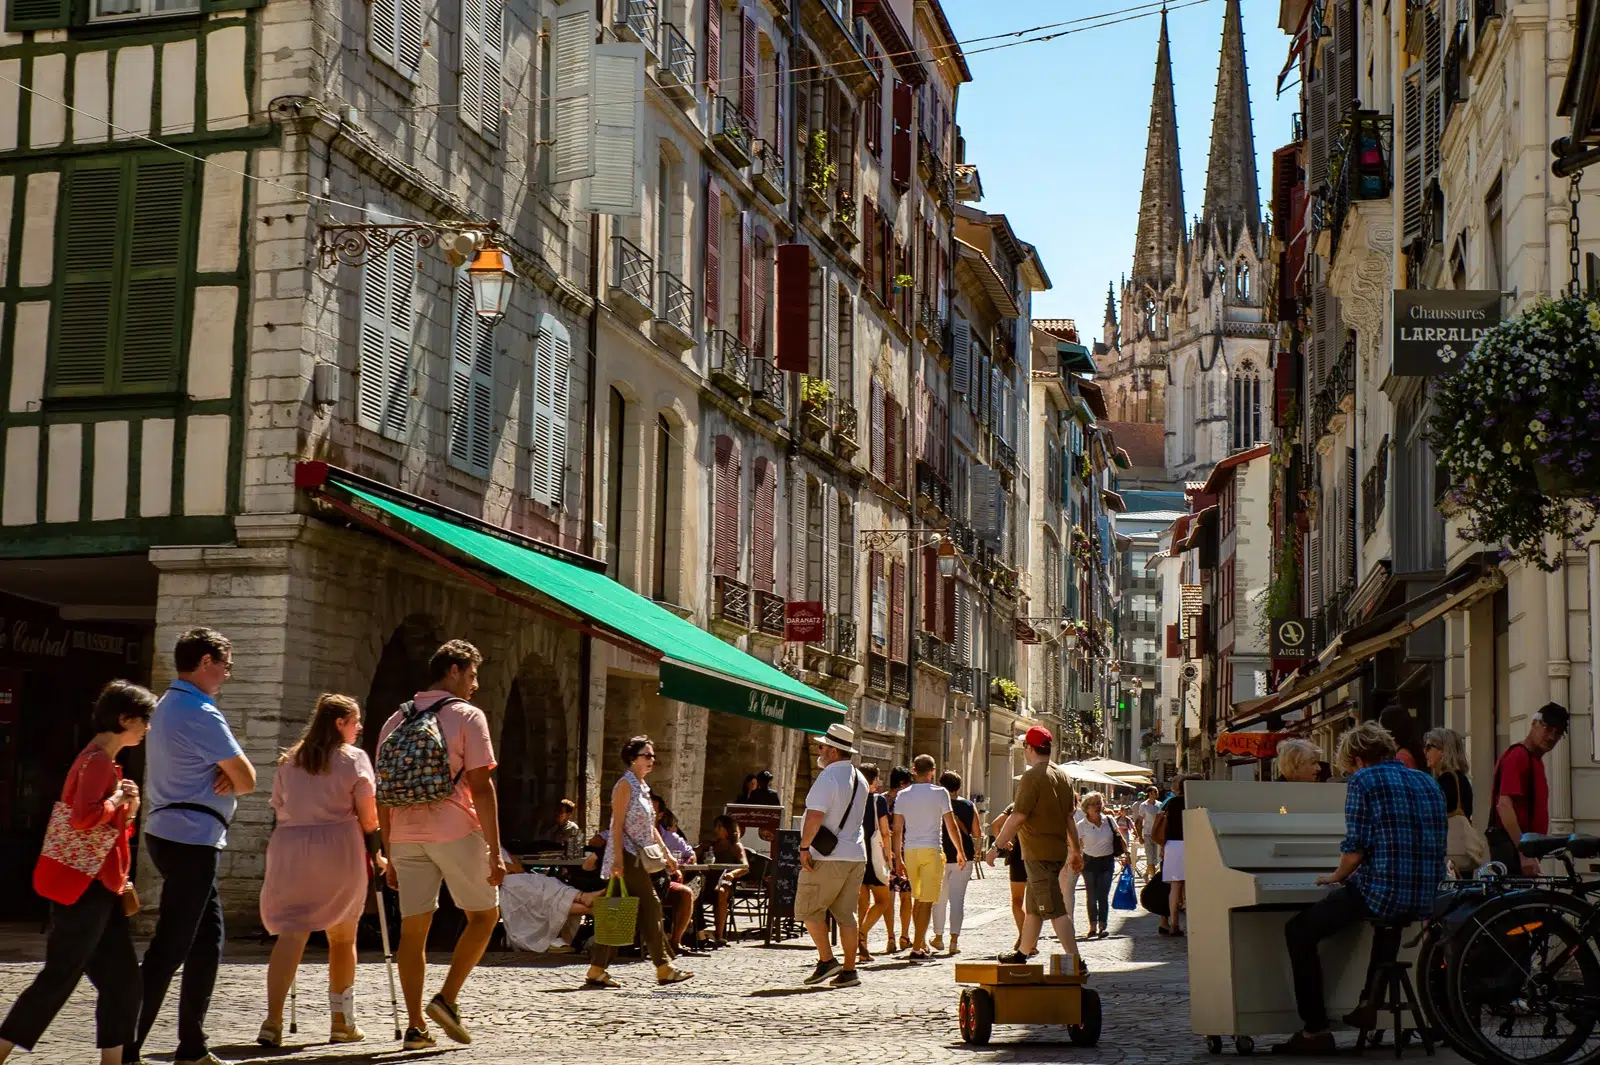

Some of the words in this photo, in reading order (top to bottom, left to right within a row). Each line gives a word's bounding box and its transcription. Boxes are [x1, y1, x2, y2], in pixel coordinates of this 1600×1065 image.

[1410, 305, 1486, 320] Chaussures
[12, 619, 71, 657] Central
[1278, 648, 1305, 656] AIGLE
[748, 690, 759, 712] Le
[760, 693, 786, 720] Central
